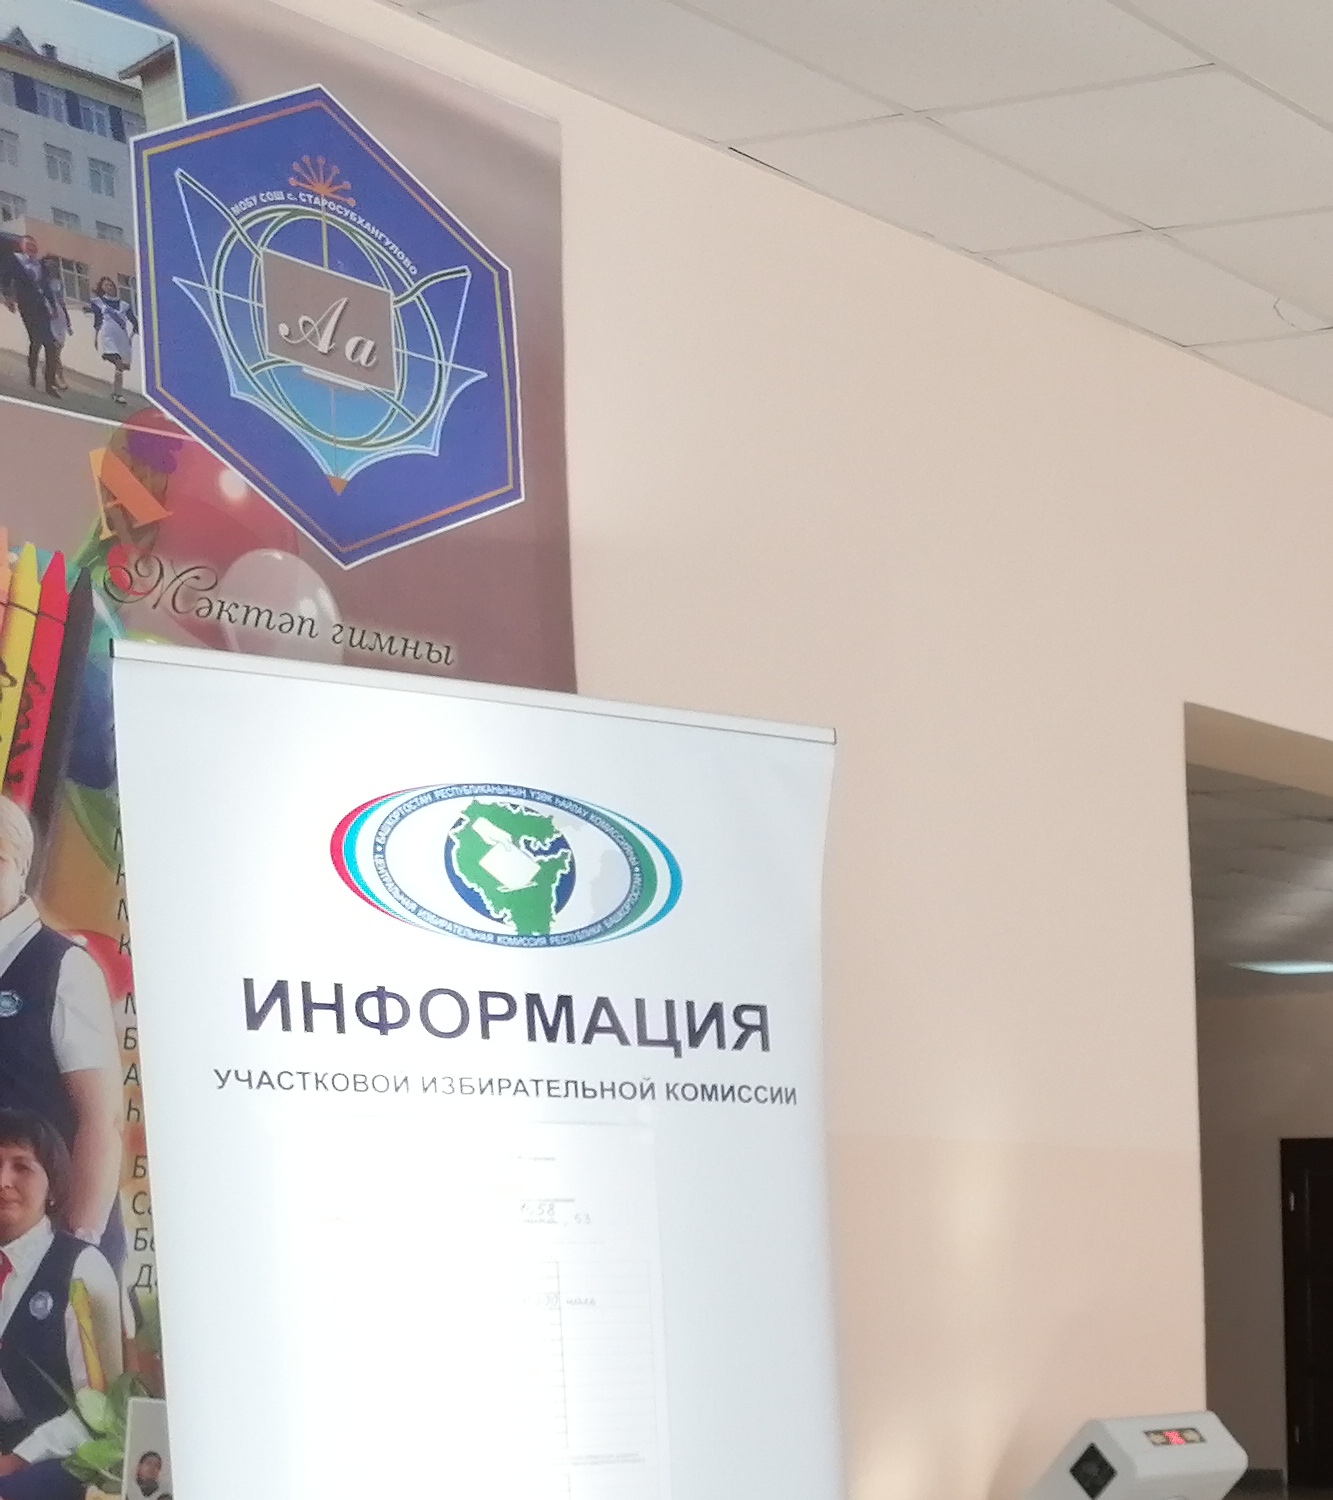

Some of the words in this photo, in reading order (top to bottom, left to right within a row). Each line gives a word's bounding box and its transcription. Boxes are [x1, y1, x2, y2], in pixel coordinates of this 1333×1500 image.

[231, 194, 257, 217] МОБУ
[259, 190, 285, 204] СОШ
[299, 192, 418, 276] СТАРОСУБХАНГУЛОВО
[331, 621, 455, 667] гимны
[242, 976, 771, 1059] ИНФОРМАЦИЯ
[421, 1075, 657, 1101] ИЗБИРАТЕЛЬНОЙ
[665, 1082, 798, 1105] КОМИССИИ
